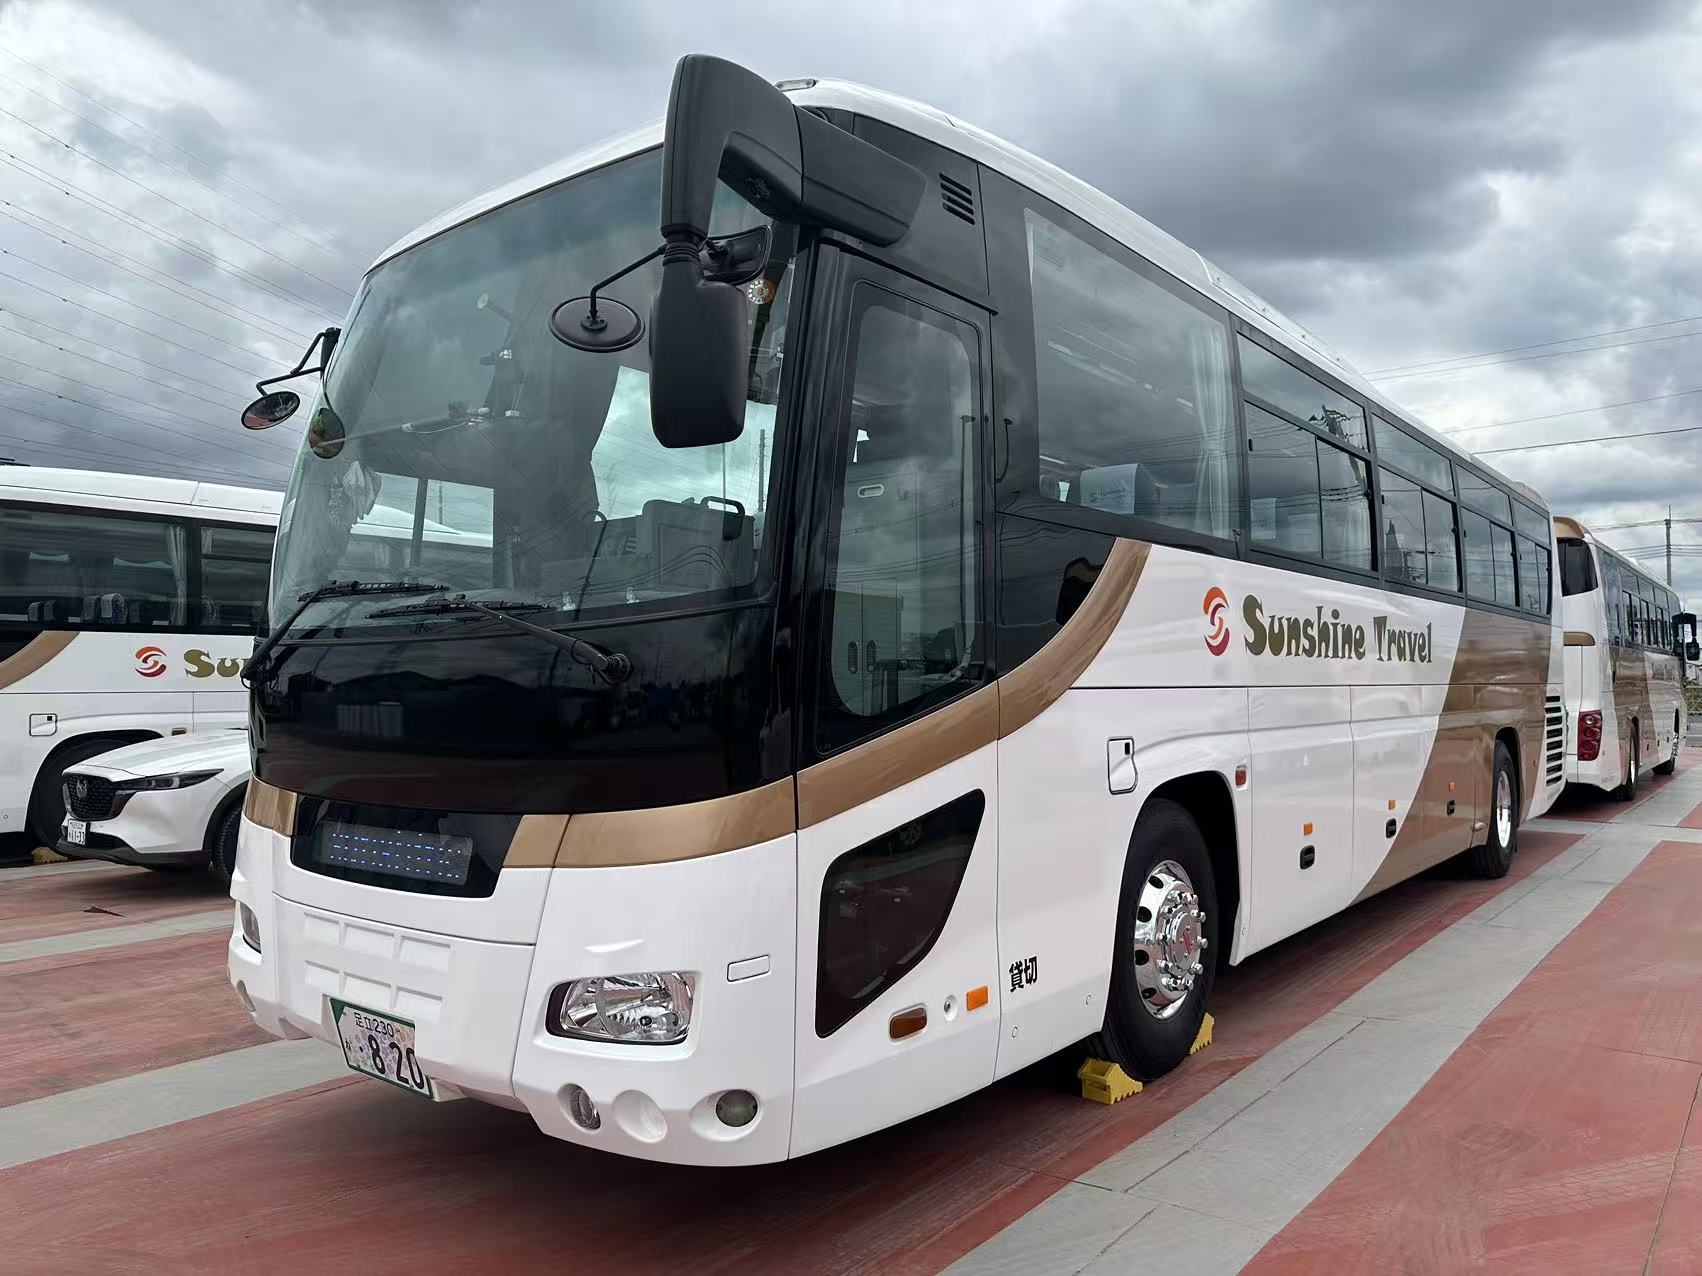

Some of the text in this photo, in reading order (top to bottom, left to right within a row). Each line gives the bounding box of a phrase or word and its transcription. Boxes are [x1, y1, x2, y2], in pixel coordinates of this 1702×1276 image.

[1243, 594, 1433, 663] Sunshine Travel
[1008, 955, 1038, 993] 貸切
